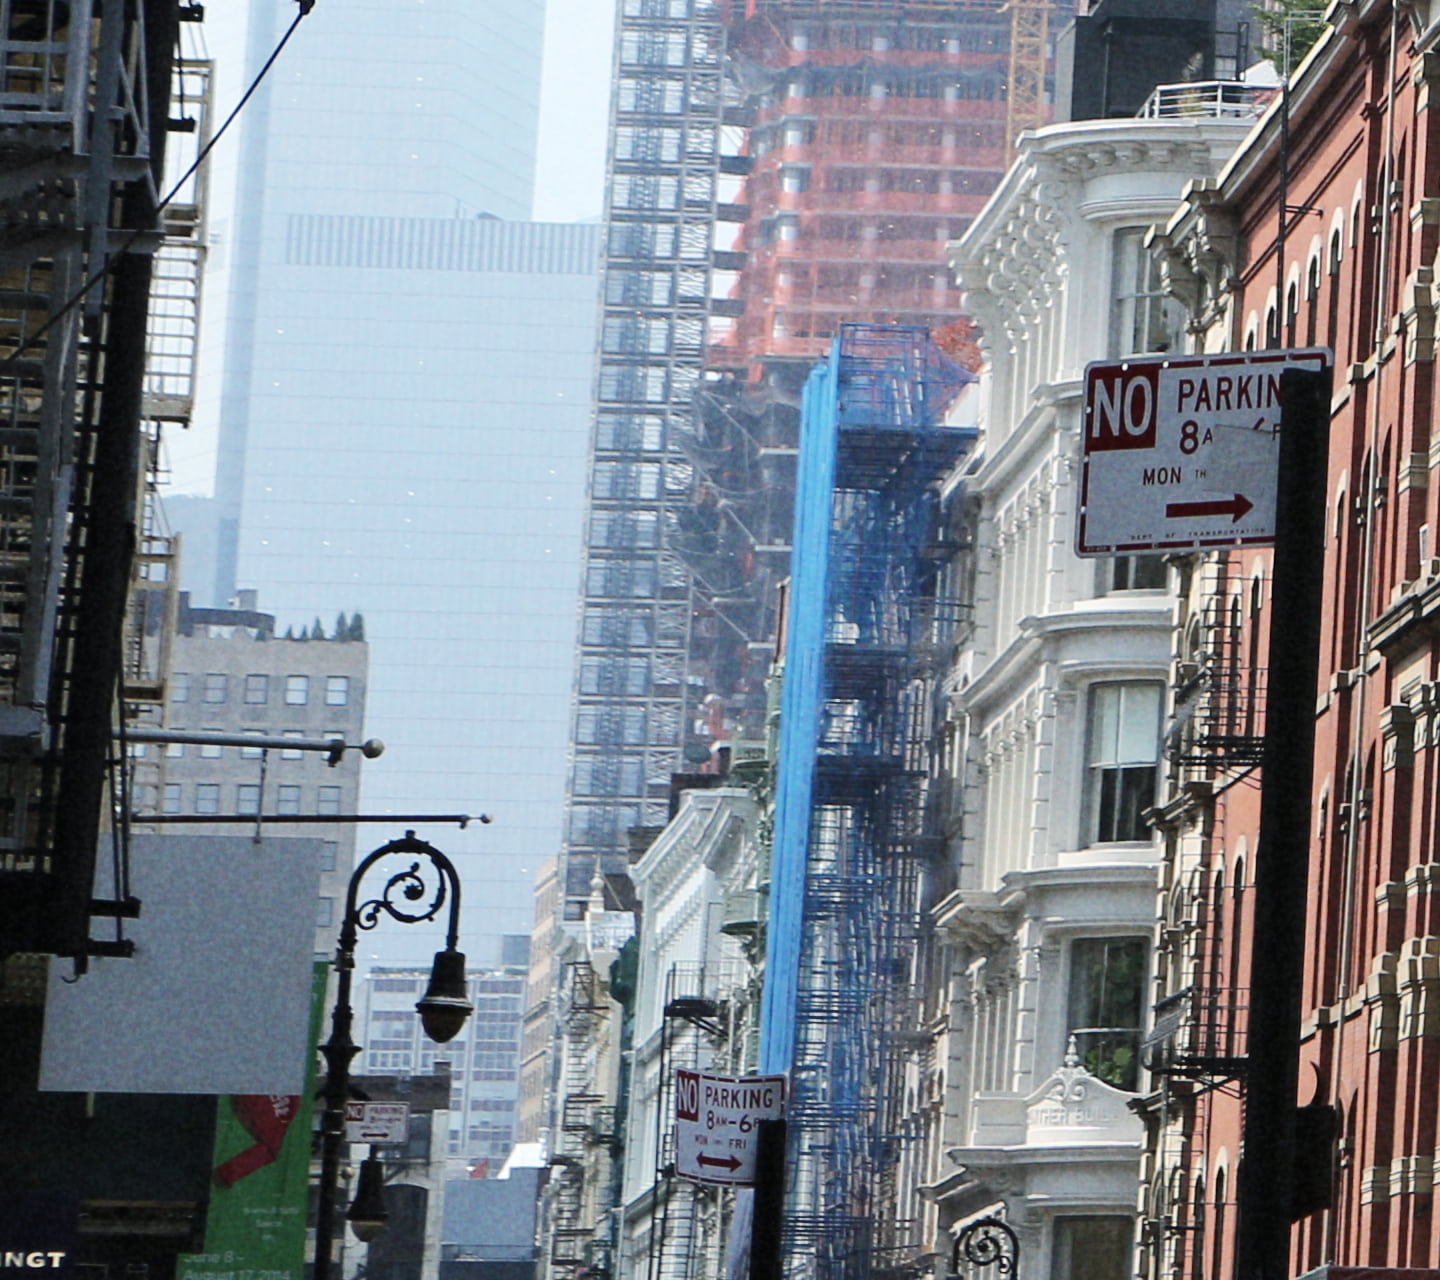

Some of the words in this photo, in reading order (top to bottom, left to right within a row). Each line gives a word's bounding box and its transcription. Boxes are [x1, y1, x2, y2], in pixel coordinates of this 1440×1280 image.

[1091, 376, 1151, 439] NO
[1178, 373, 1284, 413] PARKIN
[1142, 466, 1182, 486] MON
[678, 1075, 698, 1114] NO
[705, 1086, 773, 1109] PARKING
[706, 1110, 770, 1133] 8AM-6P
[728, 1138, 747, 1149] FRI
